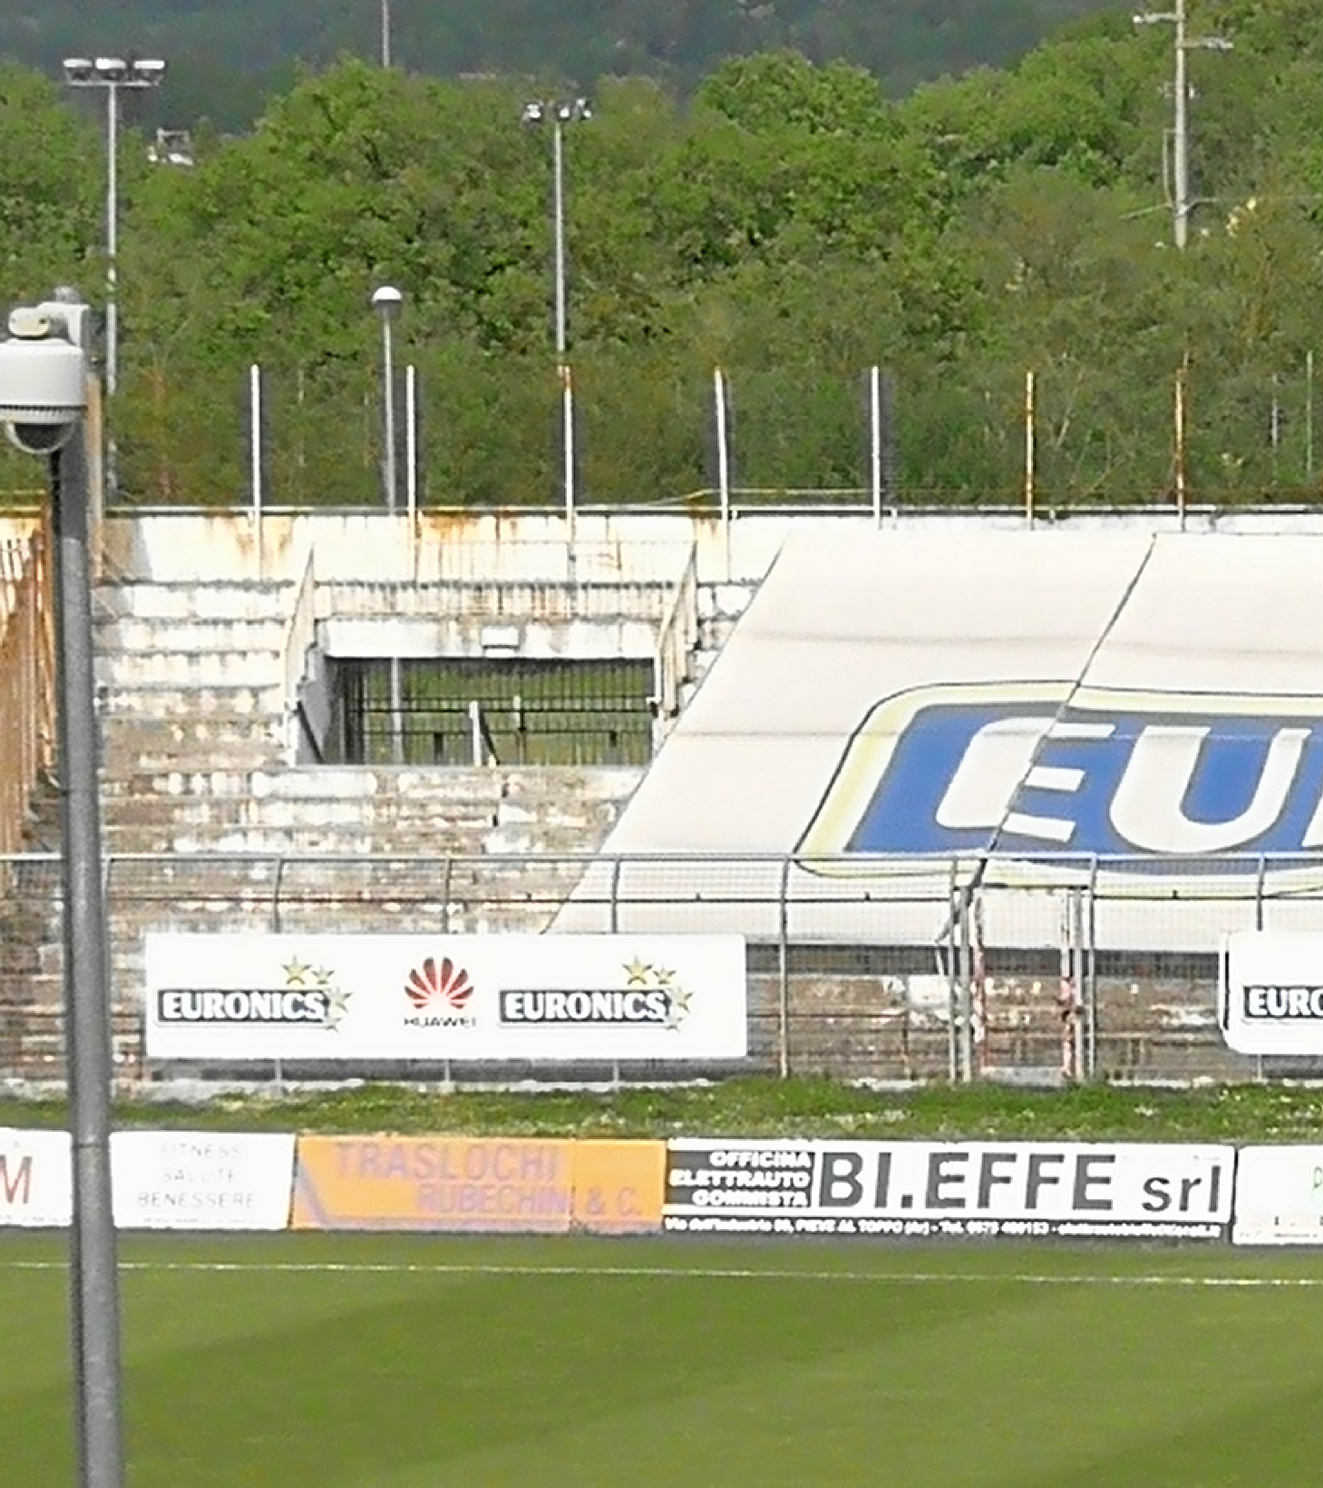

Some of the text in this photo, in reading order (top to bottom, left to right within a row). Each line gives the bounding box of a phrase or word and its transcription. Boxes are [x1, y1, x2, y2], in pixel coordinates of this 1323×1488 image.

[163, 992, 325, 1020] EURONICS
[506, 993, 665, 1020] EURONICS
[404, 1016, 476, 1027] HUAWEI
[334, 1143, 558, 1181] TRASLOCHI
[709, 1151, 811, 1168] OFFICINA
[669, 1168, 811, 1188] ELETTRAUTO
[819, 1152, 1222, 1213] BI.EFFE srl
[138, 1191, 255, 1208] BENESSERE
